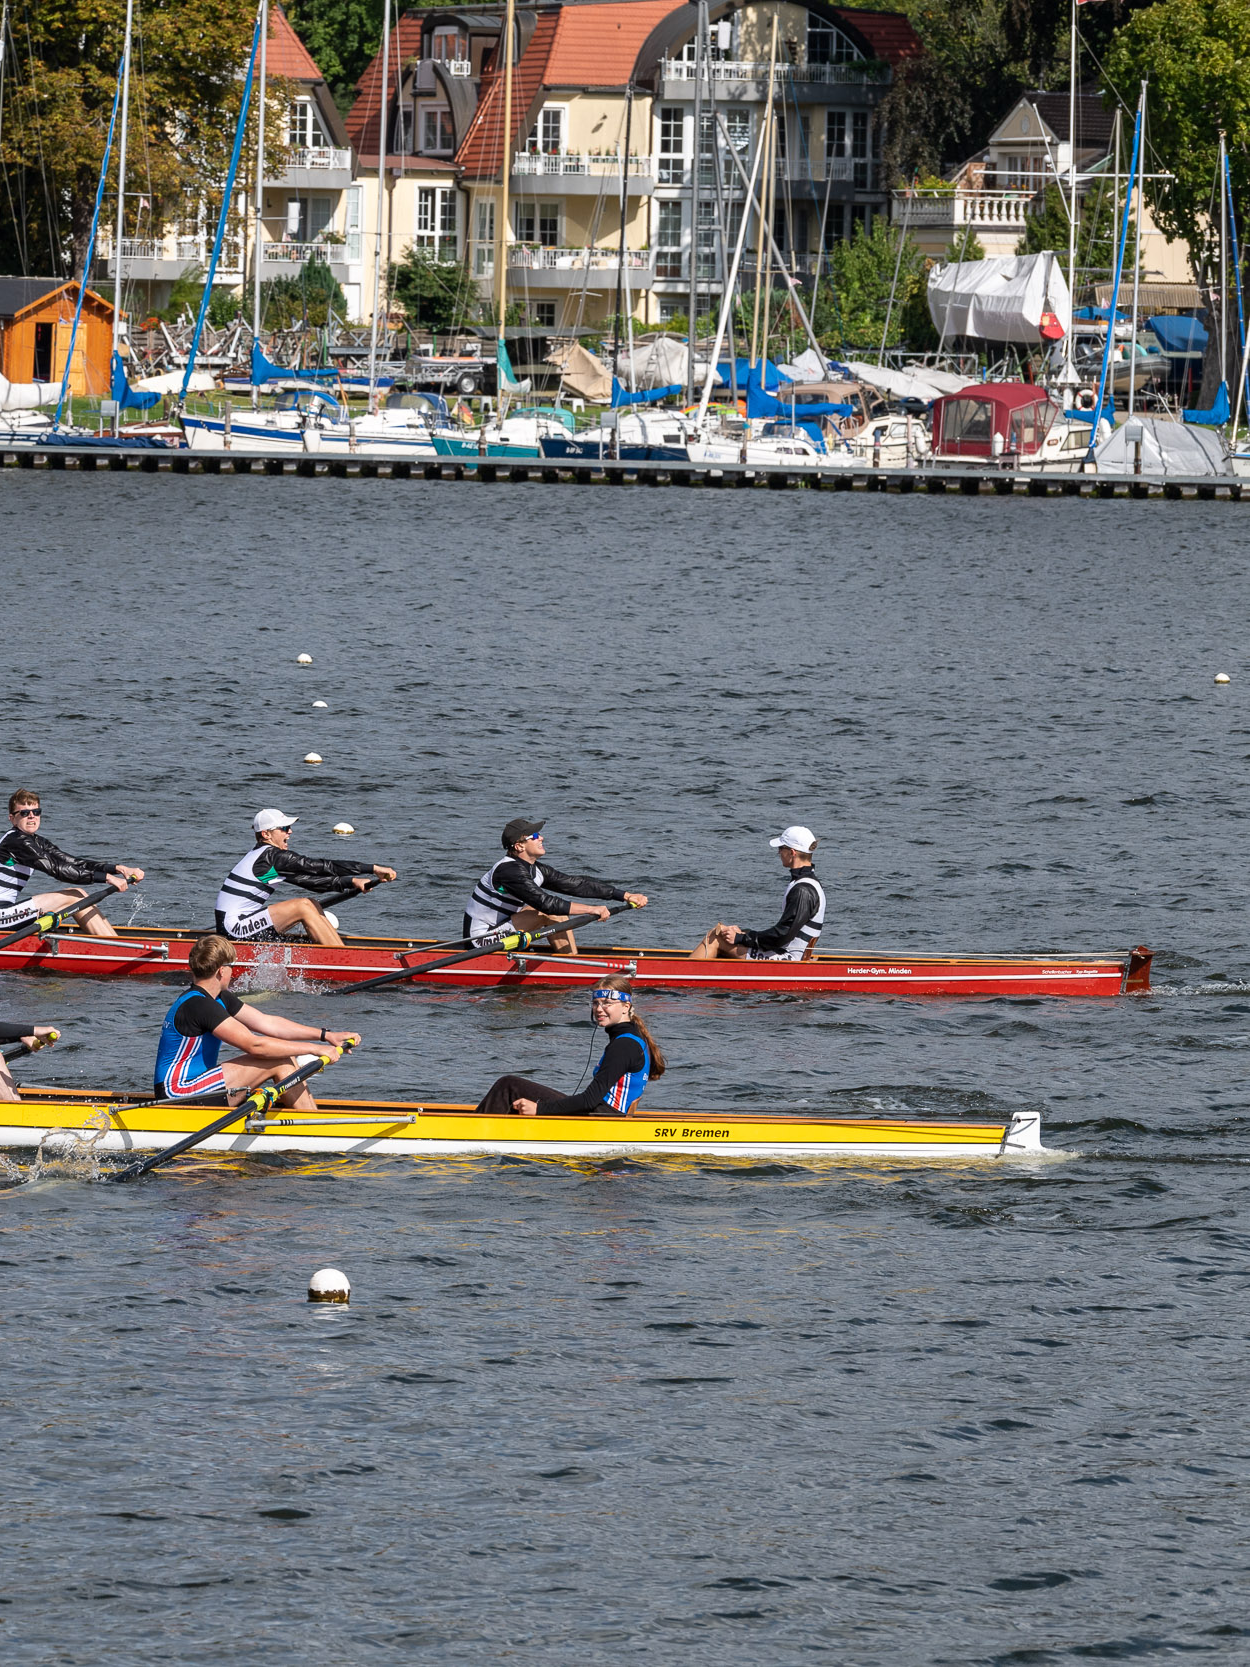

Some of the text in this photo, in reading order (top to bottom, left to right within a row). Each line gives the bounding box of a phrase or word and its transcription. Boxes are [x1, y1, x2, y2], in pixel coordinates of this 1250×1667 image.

[231, 917, 268, 936] Mnden
[654, 1128, 730, 1138] SRV Bremen
